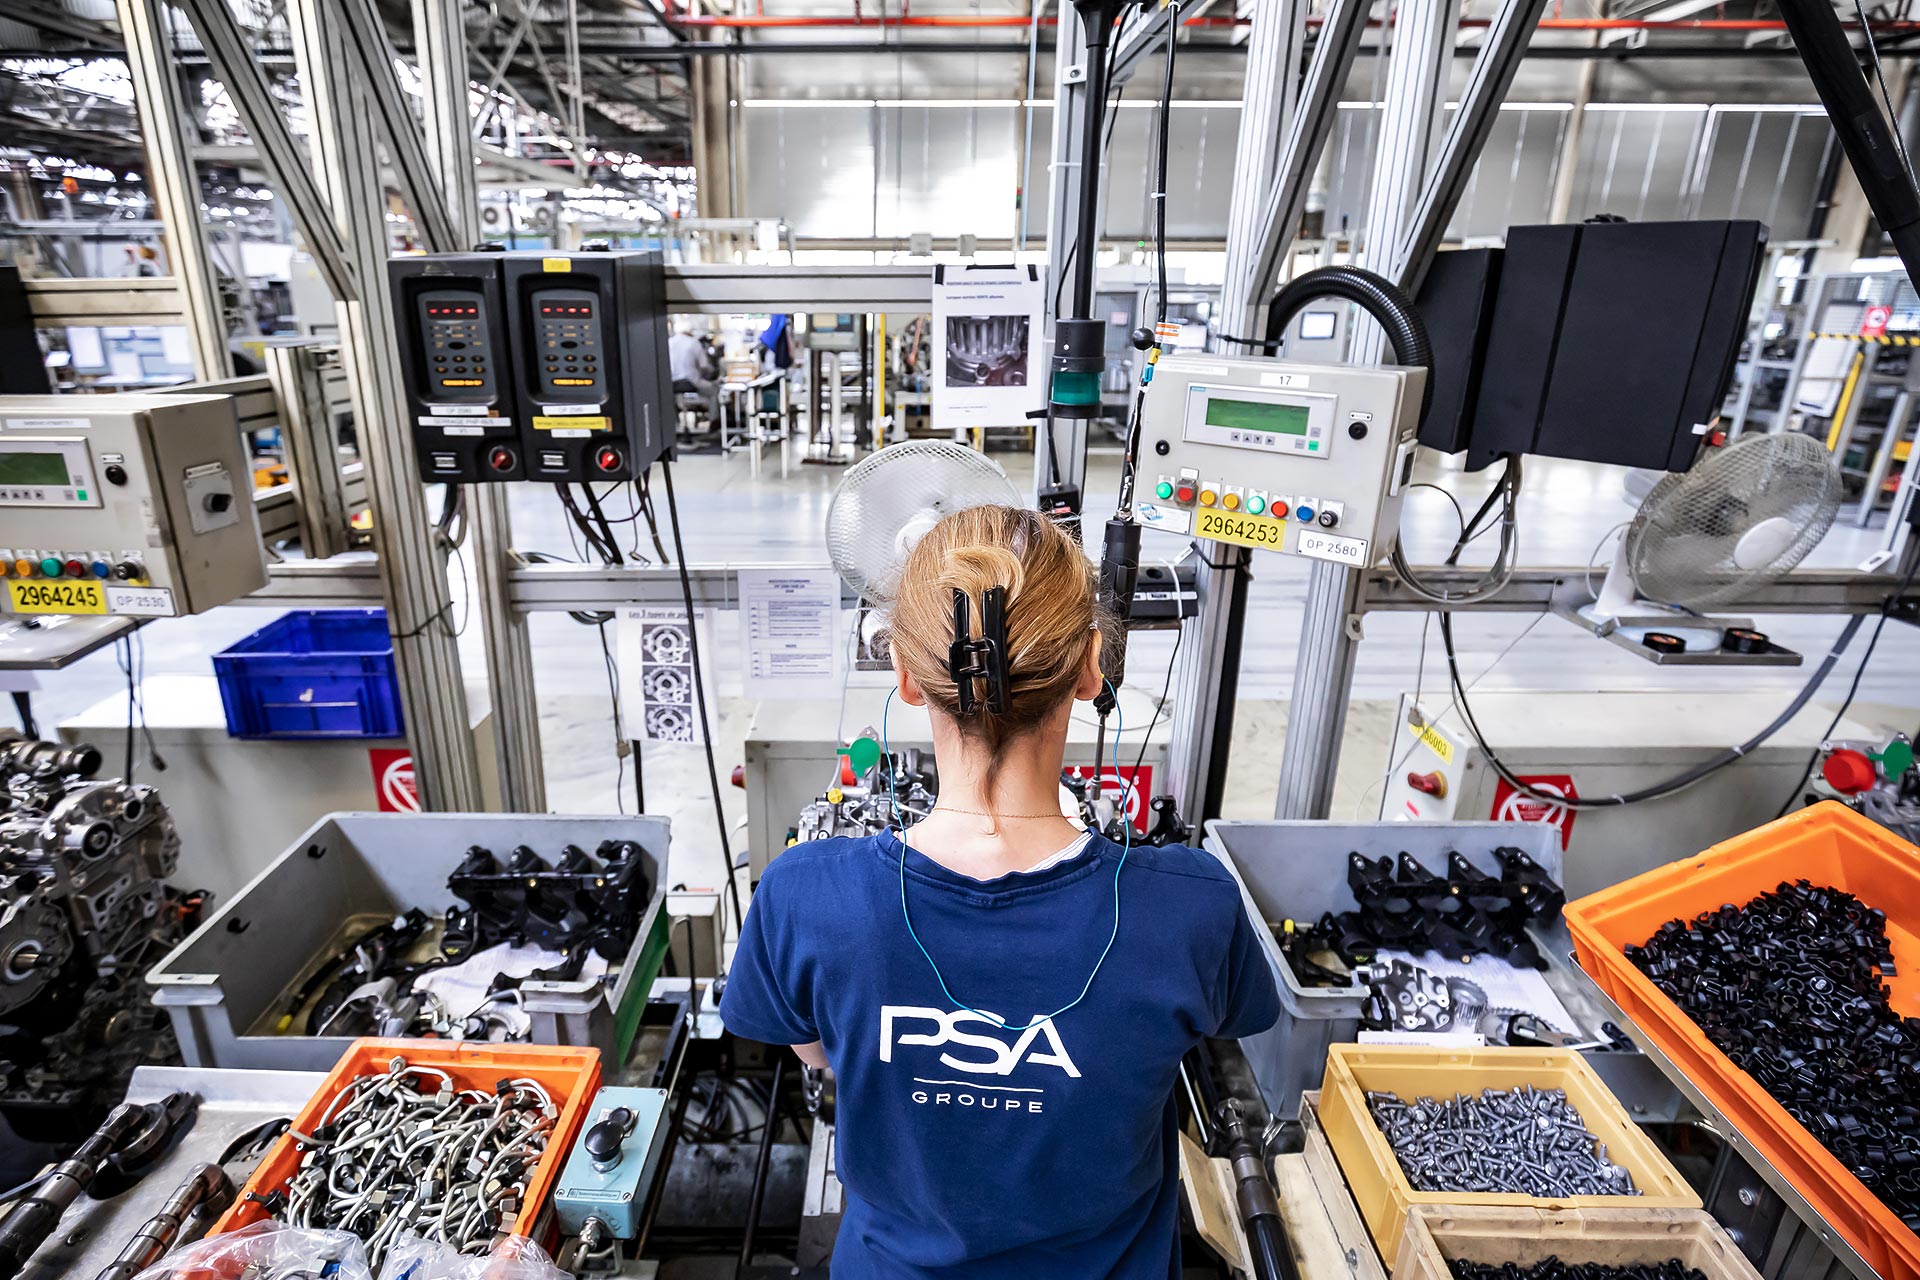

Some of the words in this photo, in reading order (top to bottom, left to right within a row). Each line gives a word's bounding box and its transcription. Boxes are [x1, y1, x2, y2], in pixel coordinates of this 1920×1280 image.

[1280, 375, 1292, 385] 17
[1202, 514, 1278, 544] 2964253
[1307, 539, 1324, 549] OP
[1327, 542, 1358, 557] 2580
[17, 585, 98, 607] 2964245
[116, 595, 134, 607] OP
[879, 1005, 1082, 1078] PSA
[911, 1091, 1043, 1113] GROUPE
